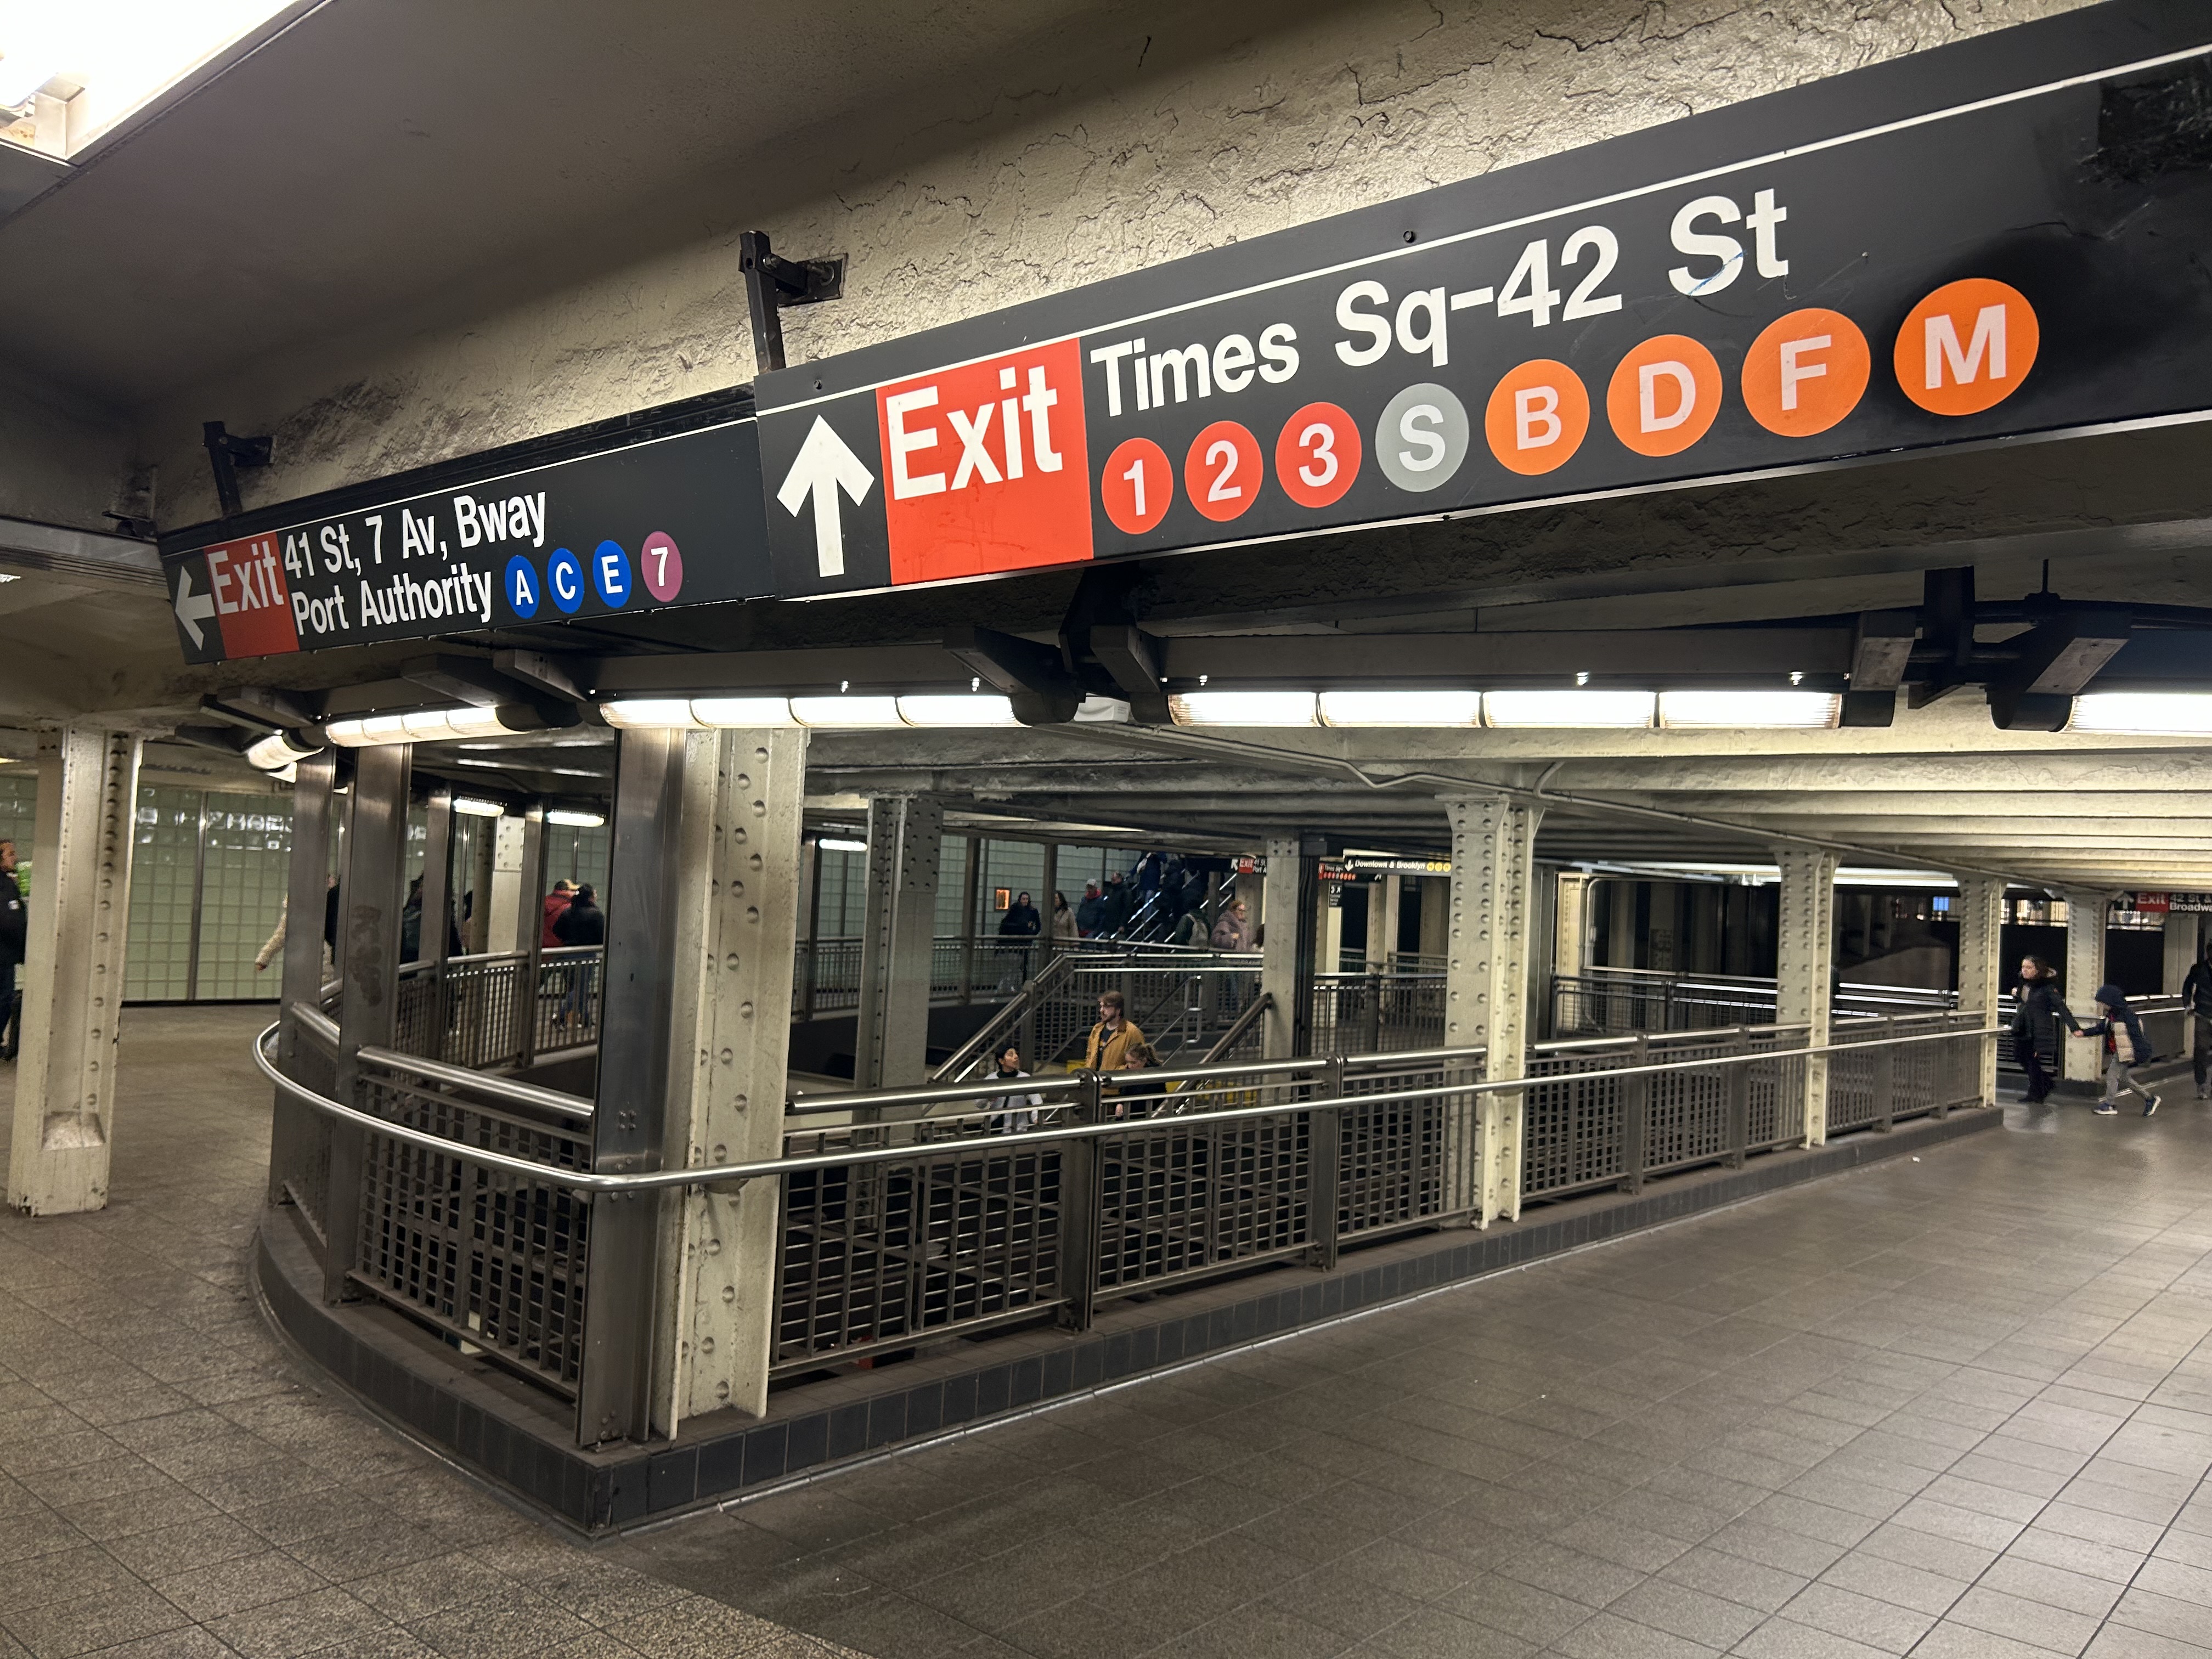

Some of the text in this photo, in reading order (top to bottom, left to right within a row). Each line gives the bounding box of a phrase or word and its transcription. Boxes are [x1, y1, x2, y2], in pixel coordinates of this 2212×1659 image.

[1090, 188, 1790, 417] Times Sq-42 St
[885, 365, 1063, 500] Exit
[1123, 303, 2007, 517] 1 2 3 S B D F M
[285, 491, 546, 579] 41 St, 7 Av, Bway
[210, 539, 284, 615] Exit
[291, 546, 669, 637] Port Authority A C E 7
[1240, 858, 1254, 868] Exit
[1355, 860, 1387, 868] Downtown
[1389, 860, 1395, 868] &
[1396, 860, 1425, 870] Brooklyn
[2137, 893, 2166, 905] Exit
[2170, 894, 2185, 902] 42
[2188, 894, 2200, 903] St
